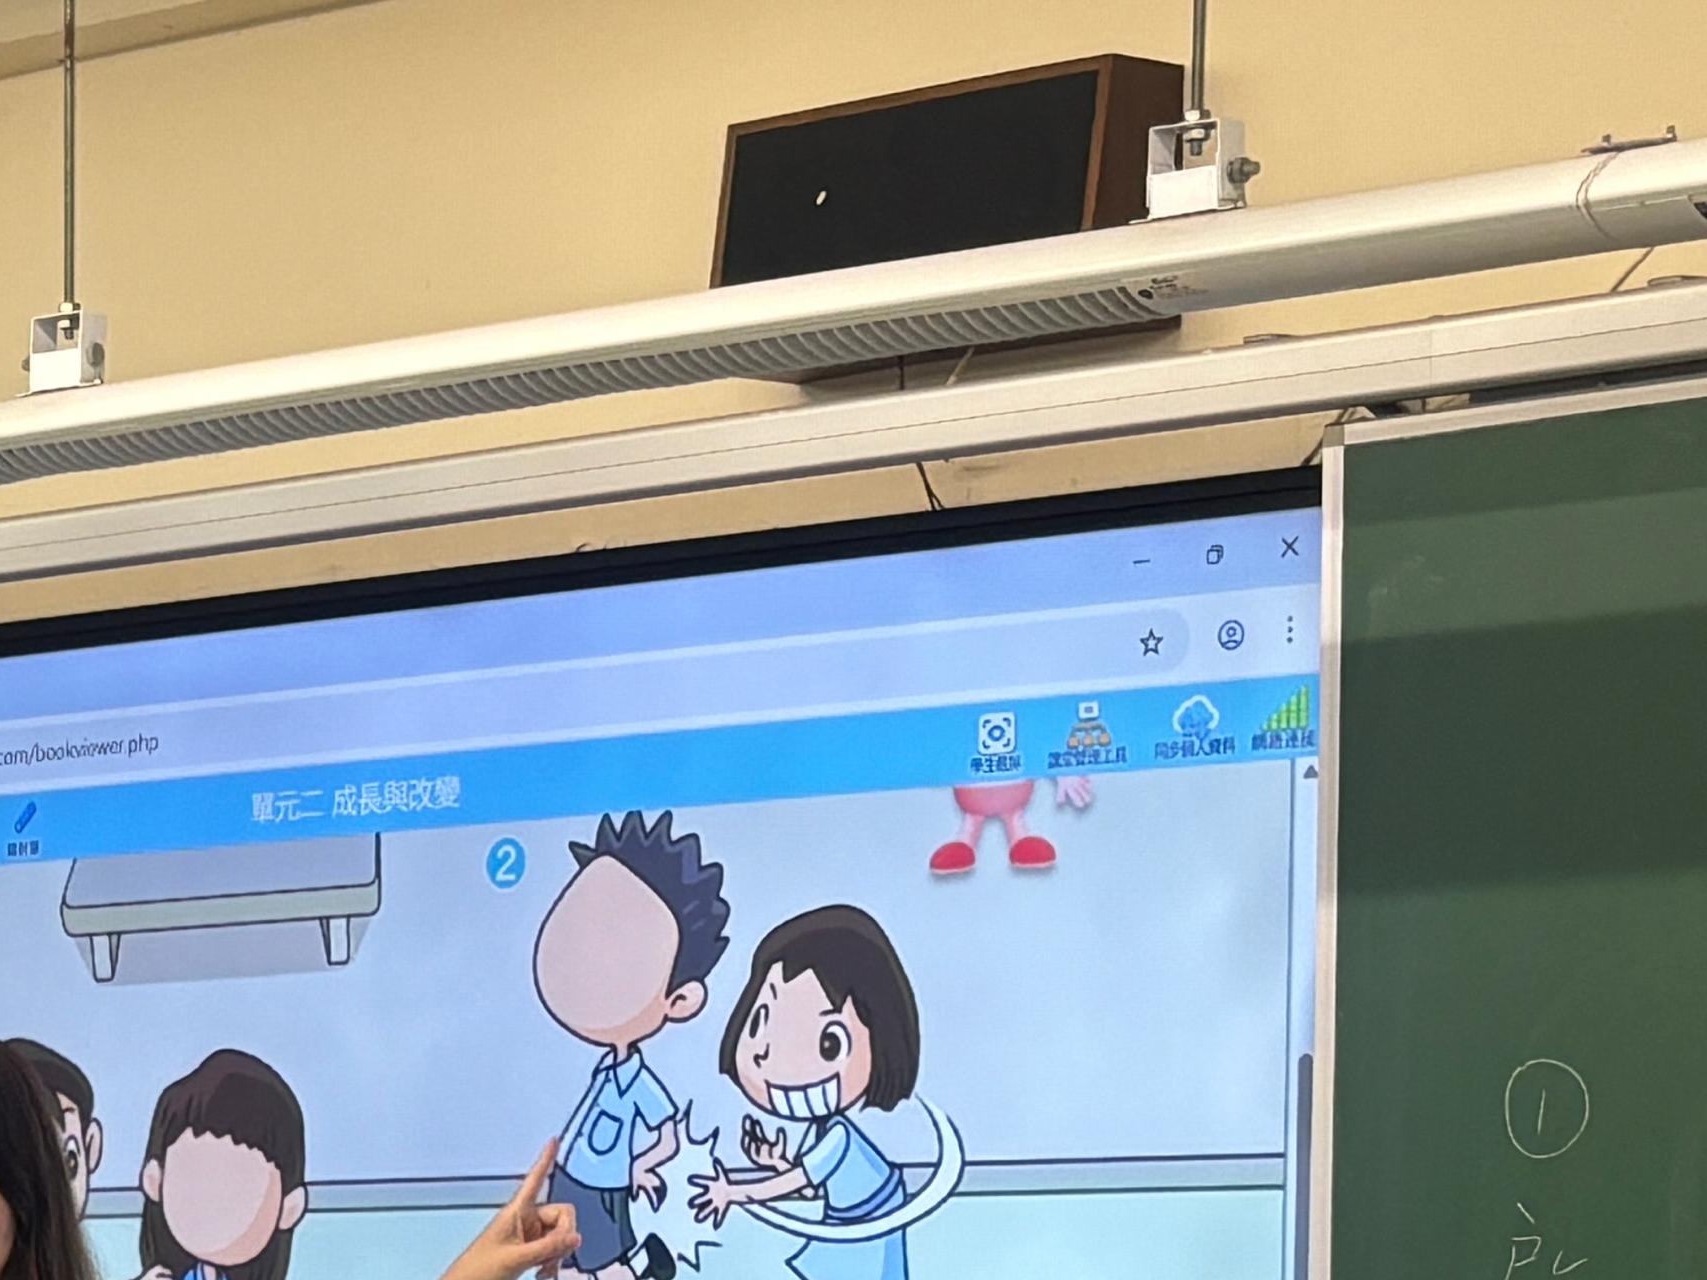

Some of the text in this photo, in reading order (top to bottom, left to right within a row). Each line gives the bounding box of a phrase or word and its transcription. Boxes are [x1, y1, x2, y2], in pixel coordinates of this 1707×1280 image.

[251, 774, 461, 823] 單元二 成長與改變
